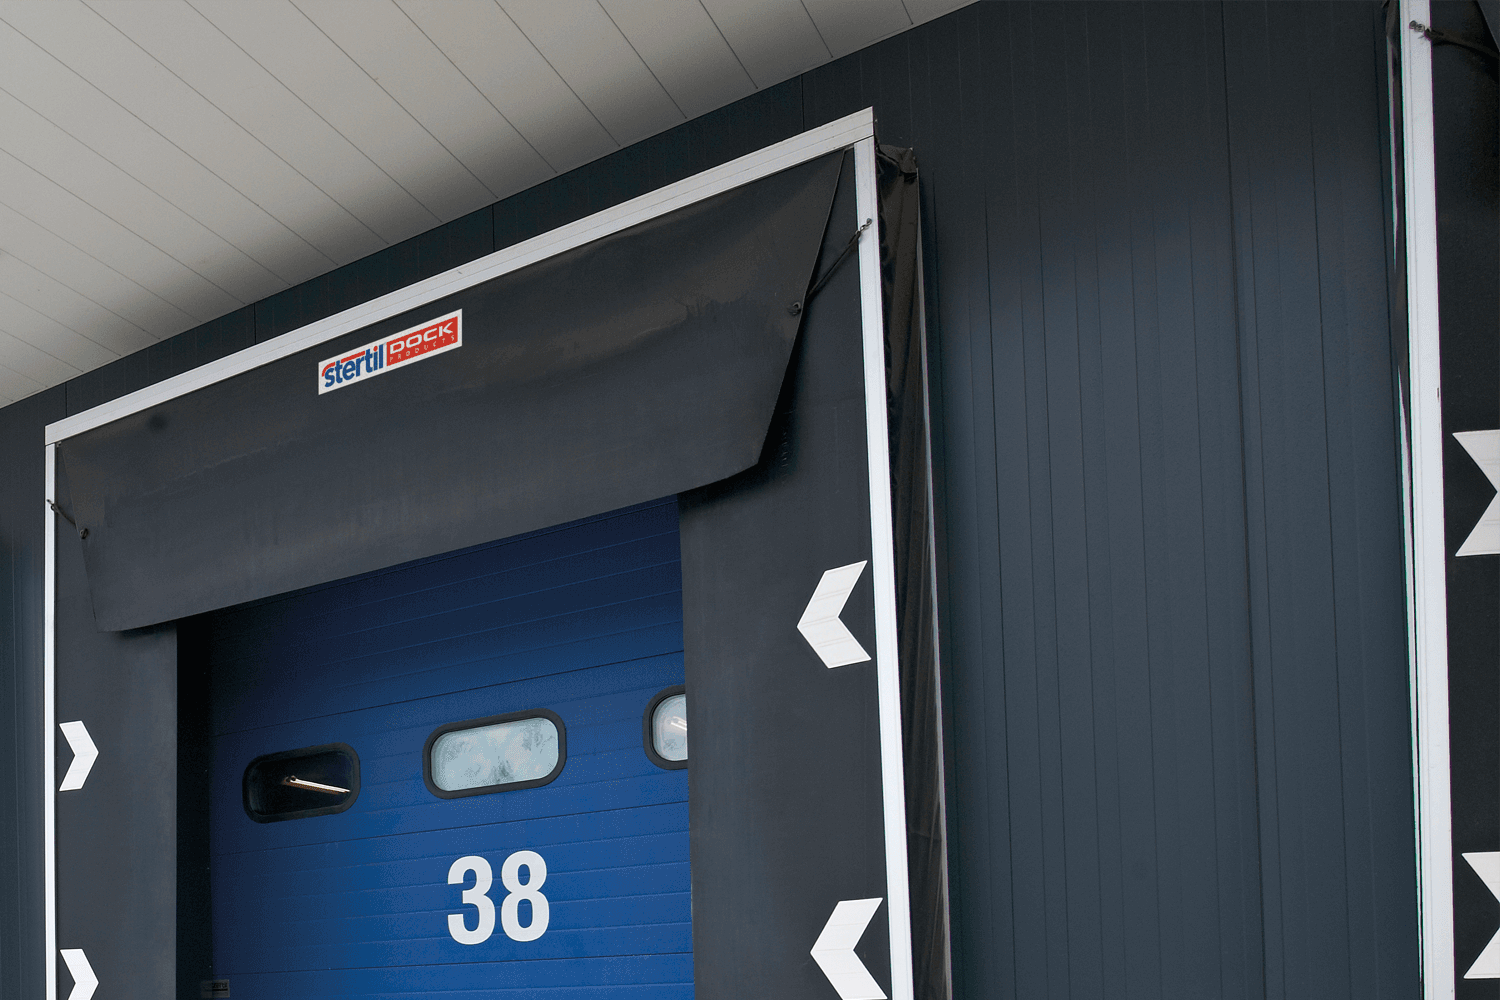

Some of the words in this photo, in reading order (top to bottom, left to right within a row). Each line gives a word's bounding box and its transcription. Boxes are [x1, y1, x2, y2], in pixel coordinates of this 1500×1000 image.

[324, 343, 384, 388] stertil
[390, 321, 454, 355] DOCK
[389, 334, 455, 363] PRODUCTS
[447, 850, 550, 946] 38
